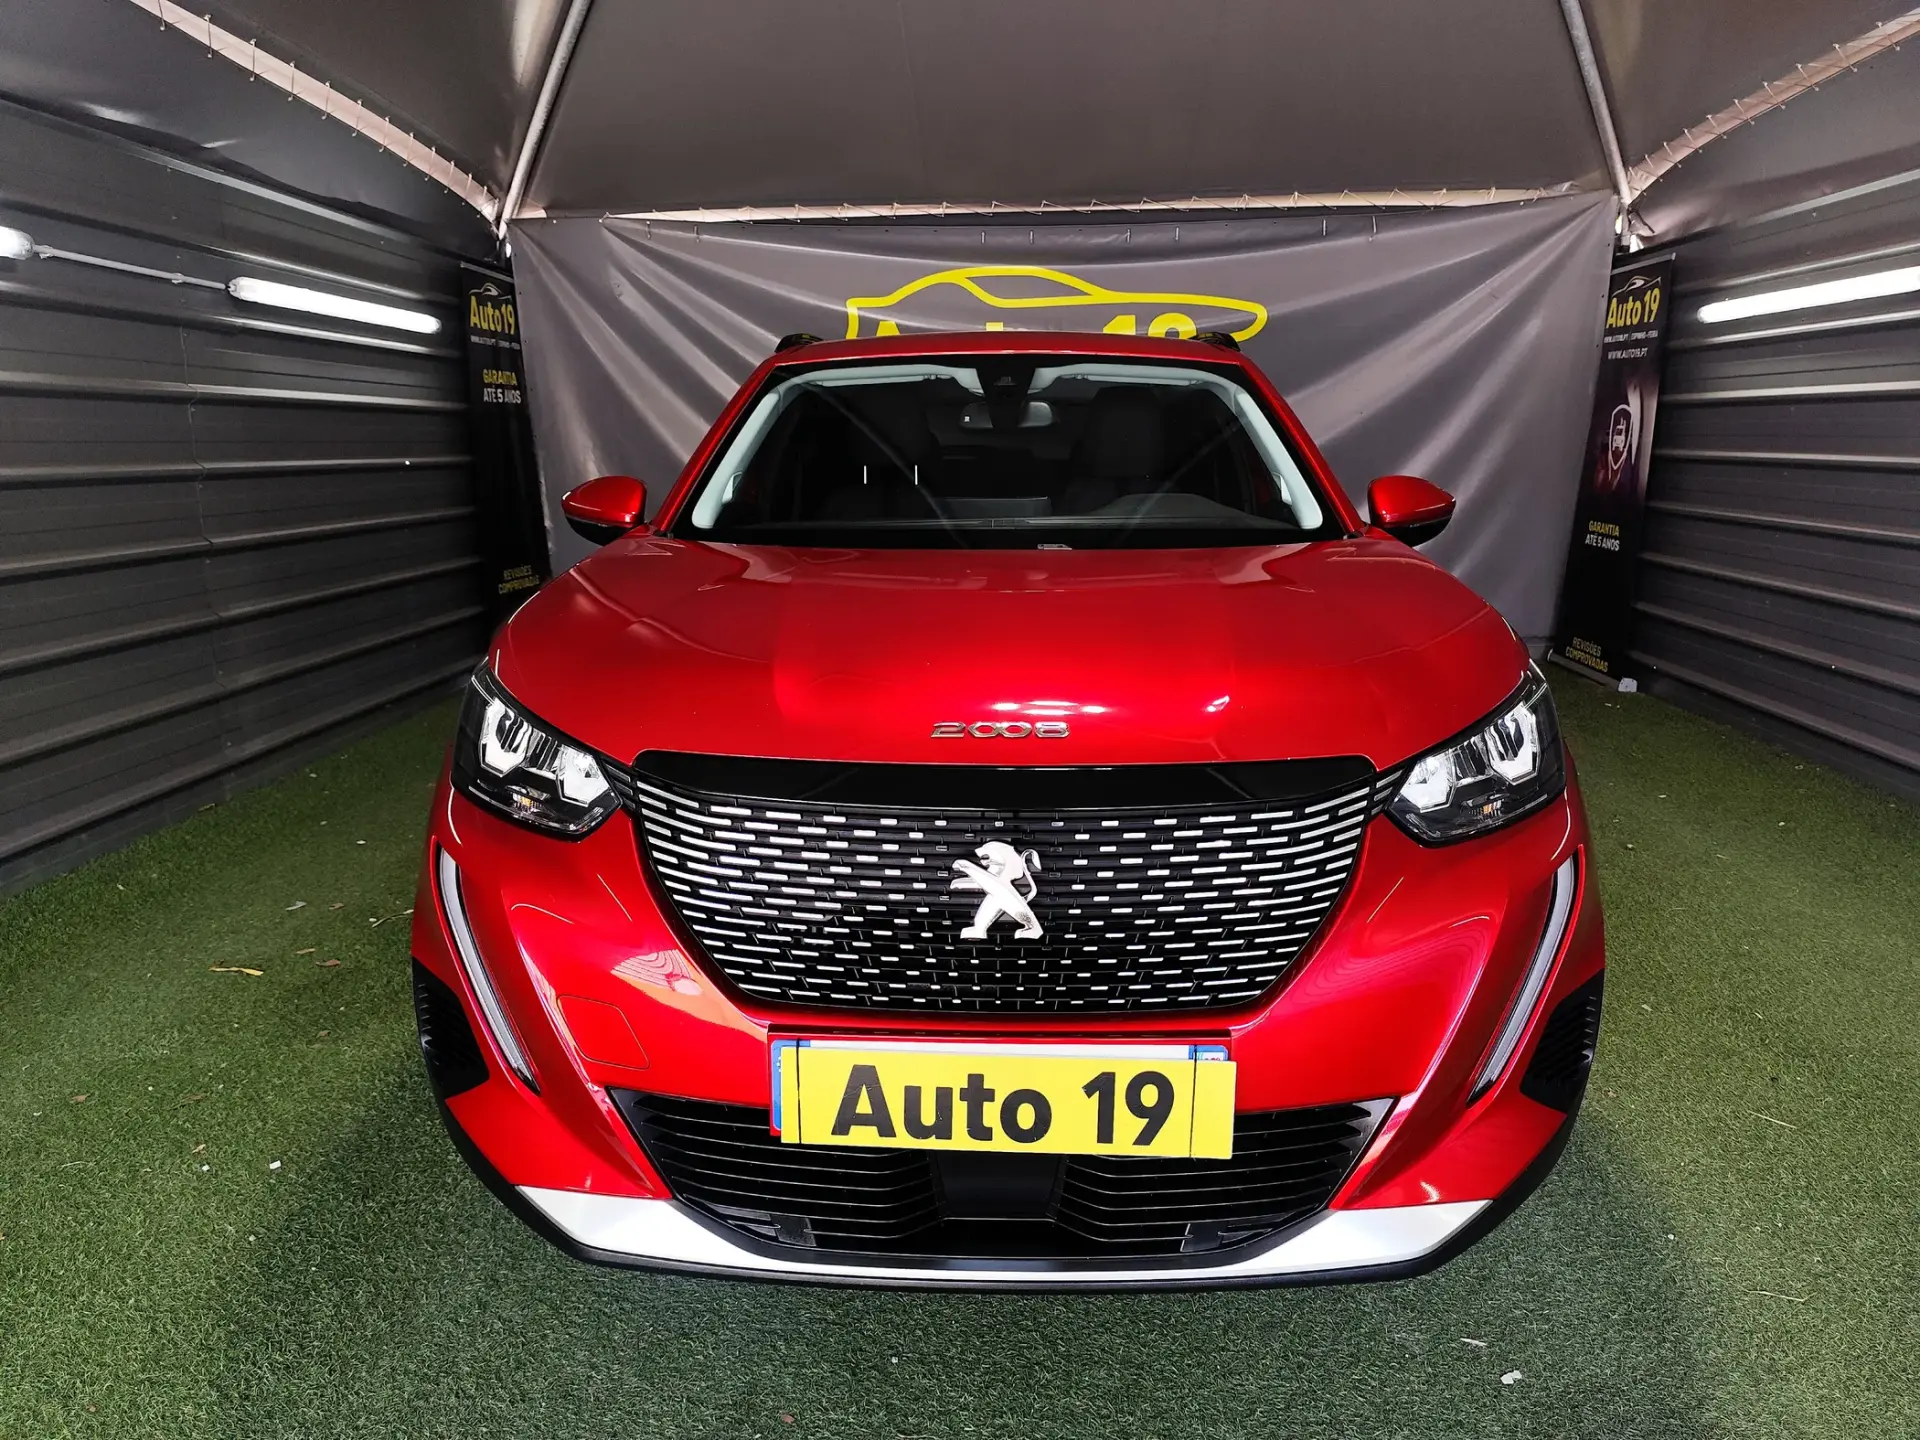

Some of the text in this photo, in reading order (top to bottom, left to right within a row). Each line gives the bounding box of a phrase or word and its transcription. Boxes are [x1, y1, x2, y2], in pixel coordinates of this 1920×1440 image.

[470, 295, 515, 335] Auto 19
[1606, 287, 1661, 329] Auto 19
[483, 385, 497, 403] ATÉ
[496, 388, 504, 403] 5
[1588, 520, 1620, 537] GARANTIA
[1585, 532, 1620, 551] ATÉ 5 ANOS
[1565, 646, 1609, 673] COMPROVADAS
[930, 721, 1071, 738] 2008
[831, 1064, 1175, 1146] Auto 19
